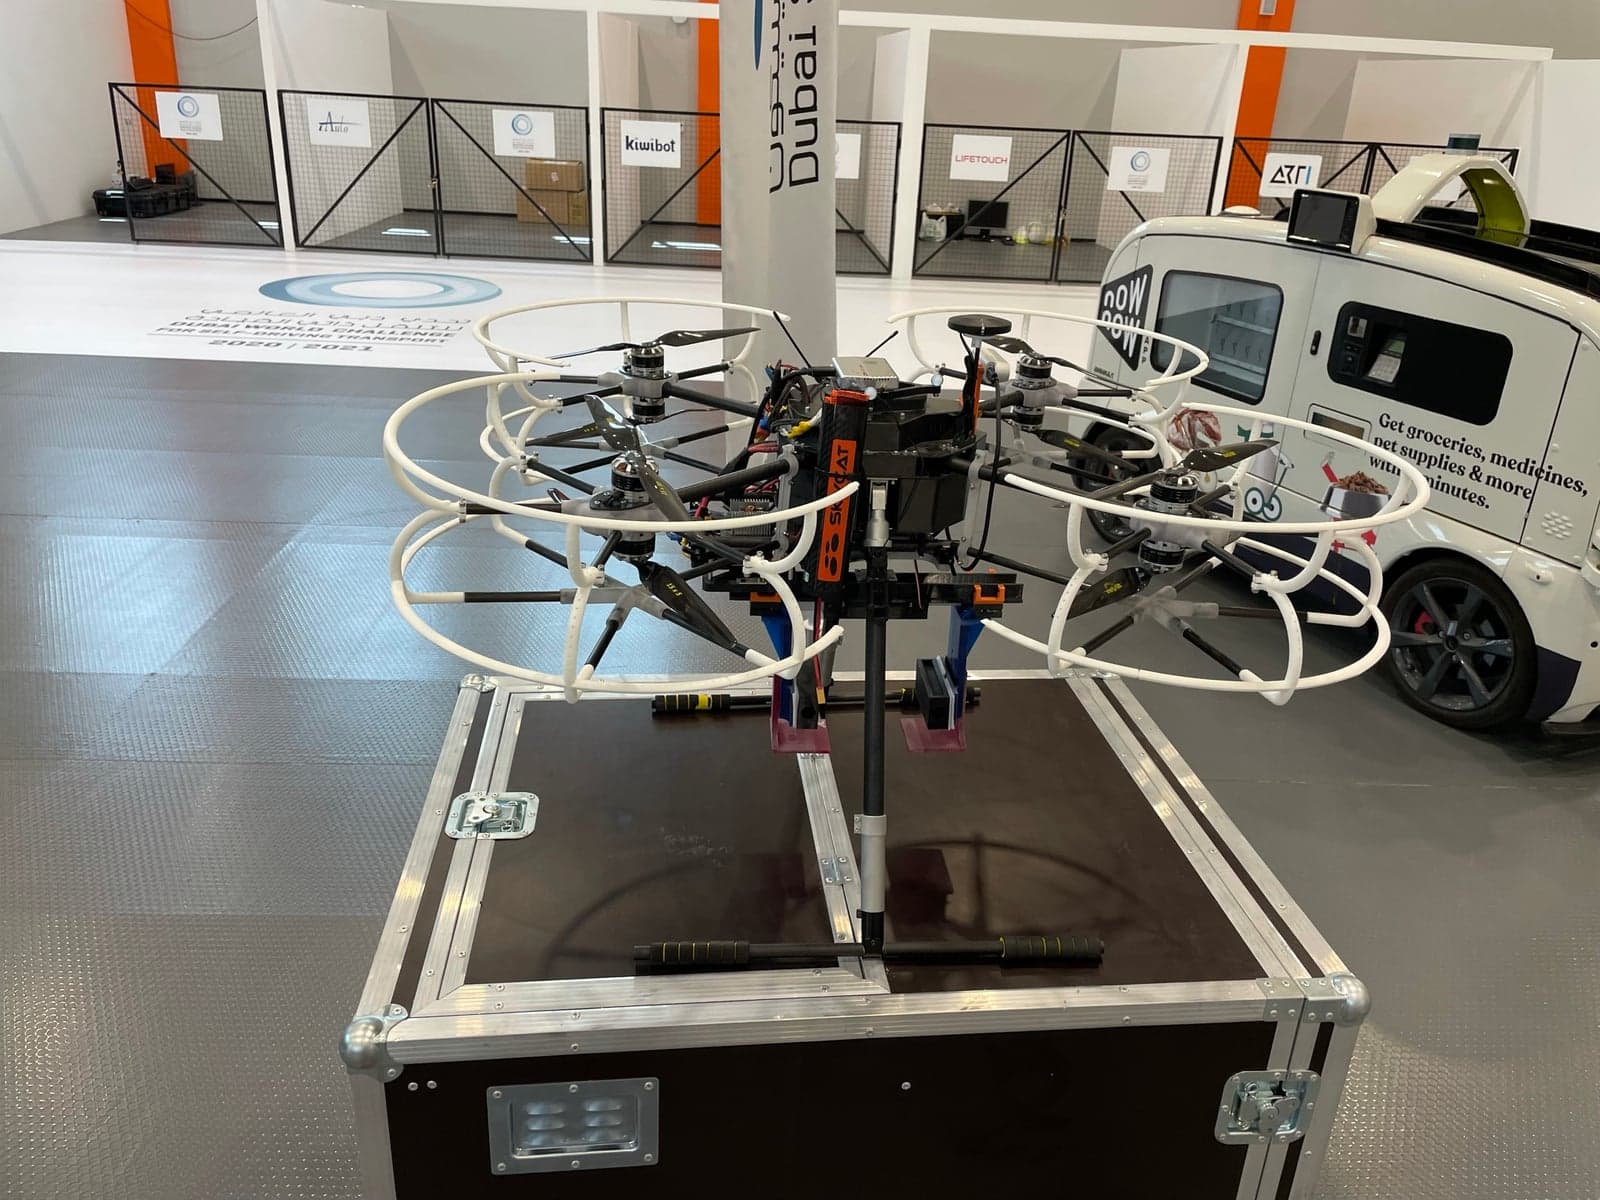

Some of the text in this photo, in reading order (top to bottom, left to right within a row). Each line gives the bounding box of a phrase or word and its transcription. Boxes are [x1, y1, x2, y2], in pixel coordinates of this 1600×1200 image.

[788, 25, 819, 187] Dubai
[625, 135, 676, 153] kiwibot
[955, 154, 1008, 165] LIFETOUCH
[244, 323, 324, 333] WORLD
[333, 327, 456, 338] CHALLENGE
[208, 339, 283, 348] 2020
[303, 342, 374, 352] 2021
[1379, 412, 1588, 497] Get groceries, medicines,
[1400, 445, 1466, 477] supplies
[1469, 465, 1483, 483] &
[1485, 473, 1533, 500] more
